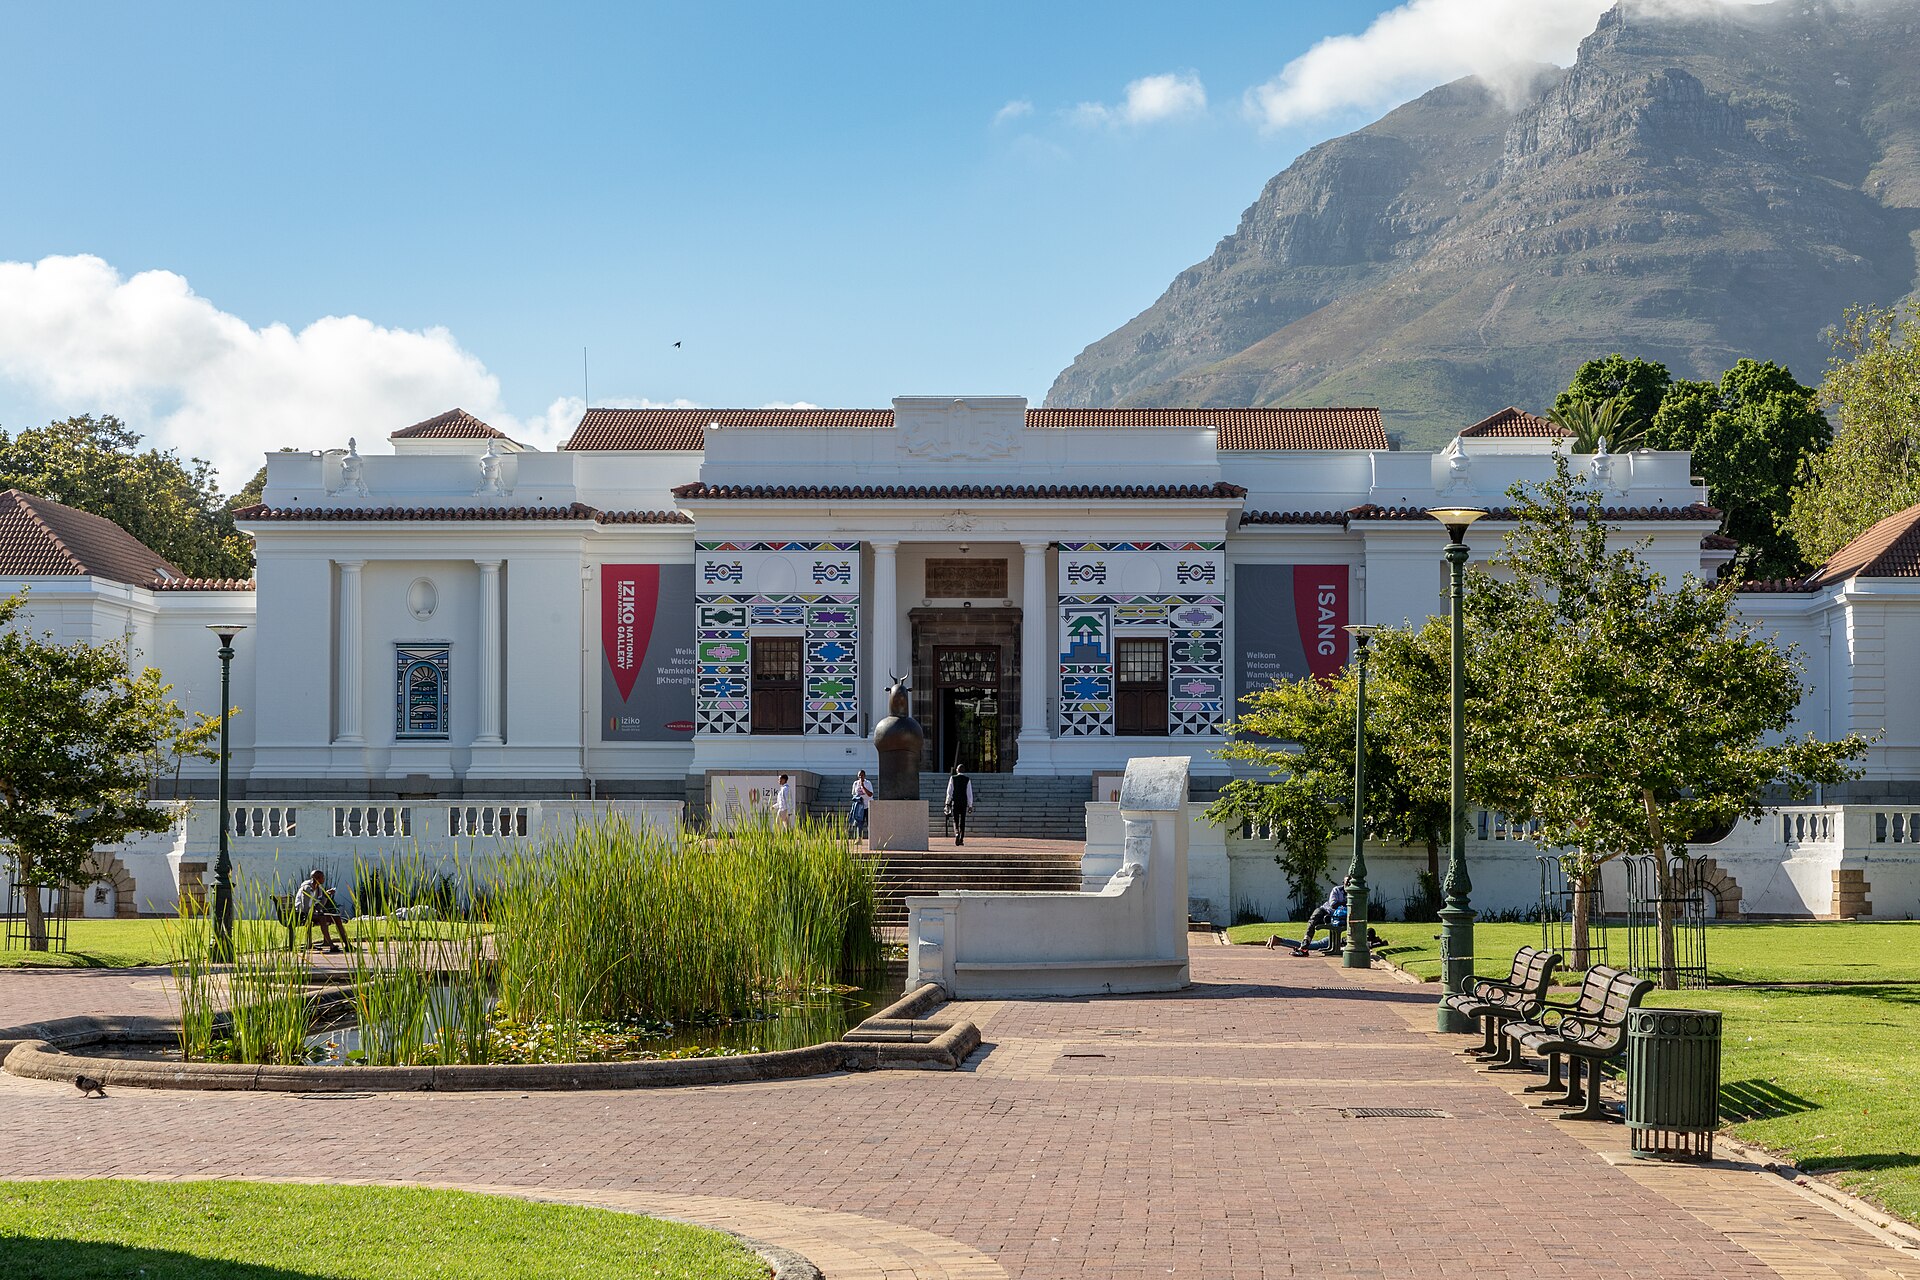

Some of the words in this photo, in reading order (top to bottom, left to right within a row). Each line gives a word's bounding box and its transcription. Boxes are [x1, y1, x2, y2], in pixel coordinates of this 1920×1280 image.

[623, 581, 635, 624] IZIKO
[1318, 585, 1336, 656] ISANG
[617, 626, 625, 670] GALLERY
[1246, 661, 1281, 669] Welcome
[1246, 671, 1294, 679] Wamkelekile
[762, 788, 778, 796] izik
